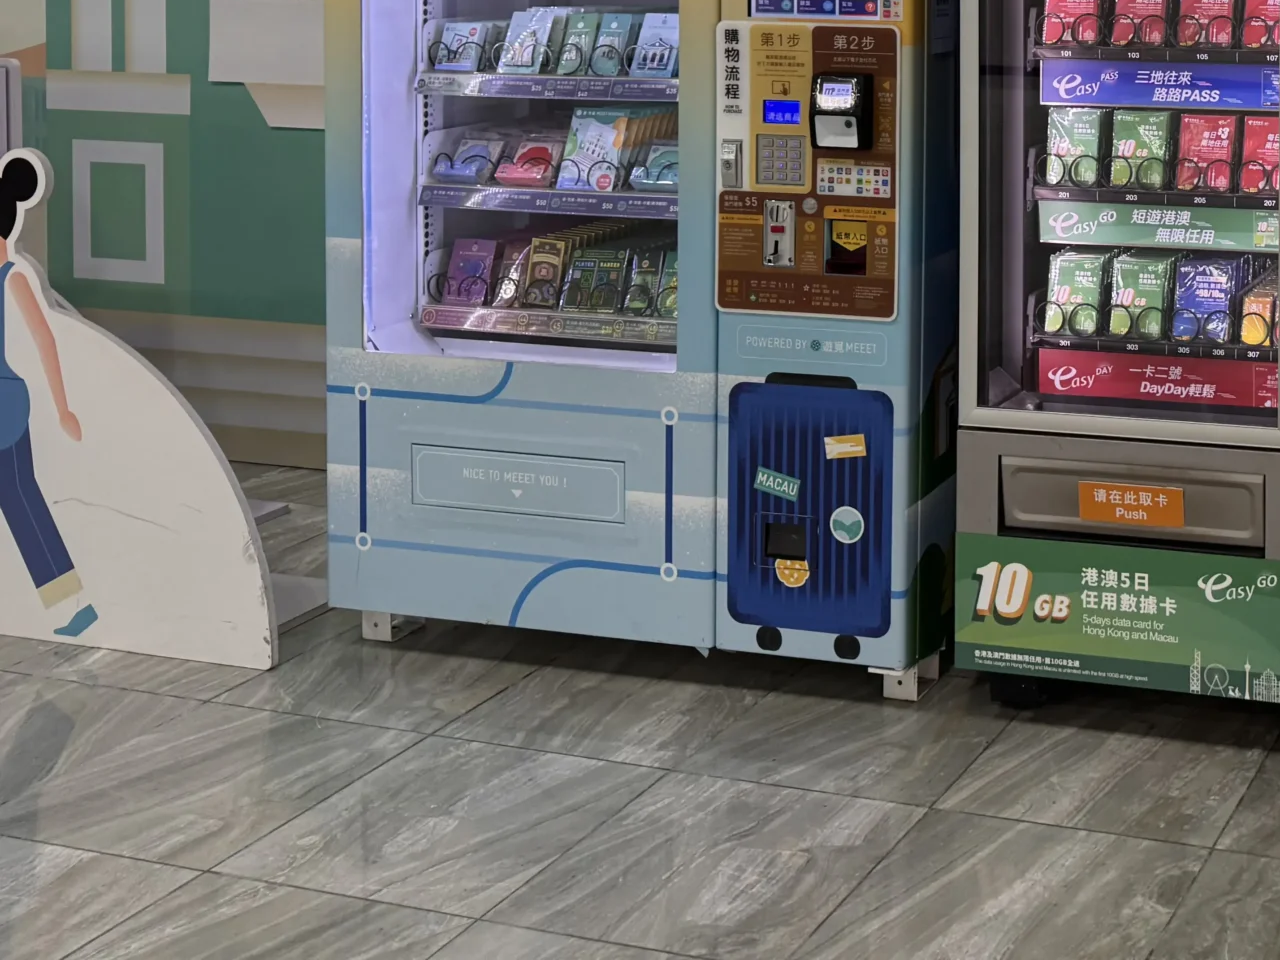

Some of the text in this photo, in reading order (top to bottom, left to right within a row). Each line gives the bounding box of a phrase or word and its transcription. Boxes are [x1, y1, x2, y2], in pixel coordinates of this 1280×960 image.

[760, 31, 801, 48] 第1步
[833, 34, 876, 50] 第2步
[724, 28, 740, 100] 購物流程
[1266, 54, 1279, 62] 107
[1100, 70, 1119, 82] PASS
[1135, 70, 1192, 85] 三地往來
[1152, 88, 1220, 103] 路路PASS
[744, 196, 758, 207] $5
[1058, 191, 1070, 199] 201
[1125, 194, 1138, 202] 203
[1193, 196, 1207, 204] 205
[1263, 199, 1276, 207] 207
[1099, 210, 1117, 224] GO
[1130, 209, 1191, 226] 短遊港澳
[1155, 228, 1215, 245] 無限任用
[746, 336, 793, 350] POWERED
[795, 338, 807, 350] BY
[1177, 346, 1190, 354] 305
[1212, 348, 1225, 356] 306
[1247, 350, 1260, 358] 307
[1095, 365, 1114, 376] DAY
[1129, 366, 1183, 381] 一卡二號
[1140, 381, 1216, 400] DayDay輕鬆
[462, 467, 559, 488] NICE TO MEEET YOU
[756, 471, 799, 497] MACAU
[1093, 488, 1169, 507] 请在此取卡
[1115, 507, 1147, 521] Push
[1080, 567, 1150, 592] 港澳5日
[1257, 573, 1278, 588] GO
[973, 561, 1071, 622] 10 GB
[1080, 589, 1178, 617] 任用數據卡
[1082, 614, 1165, 630] 5-days data card for
[1082, 625, 1179, 644] Hong Kong and Macau
